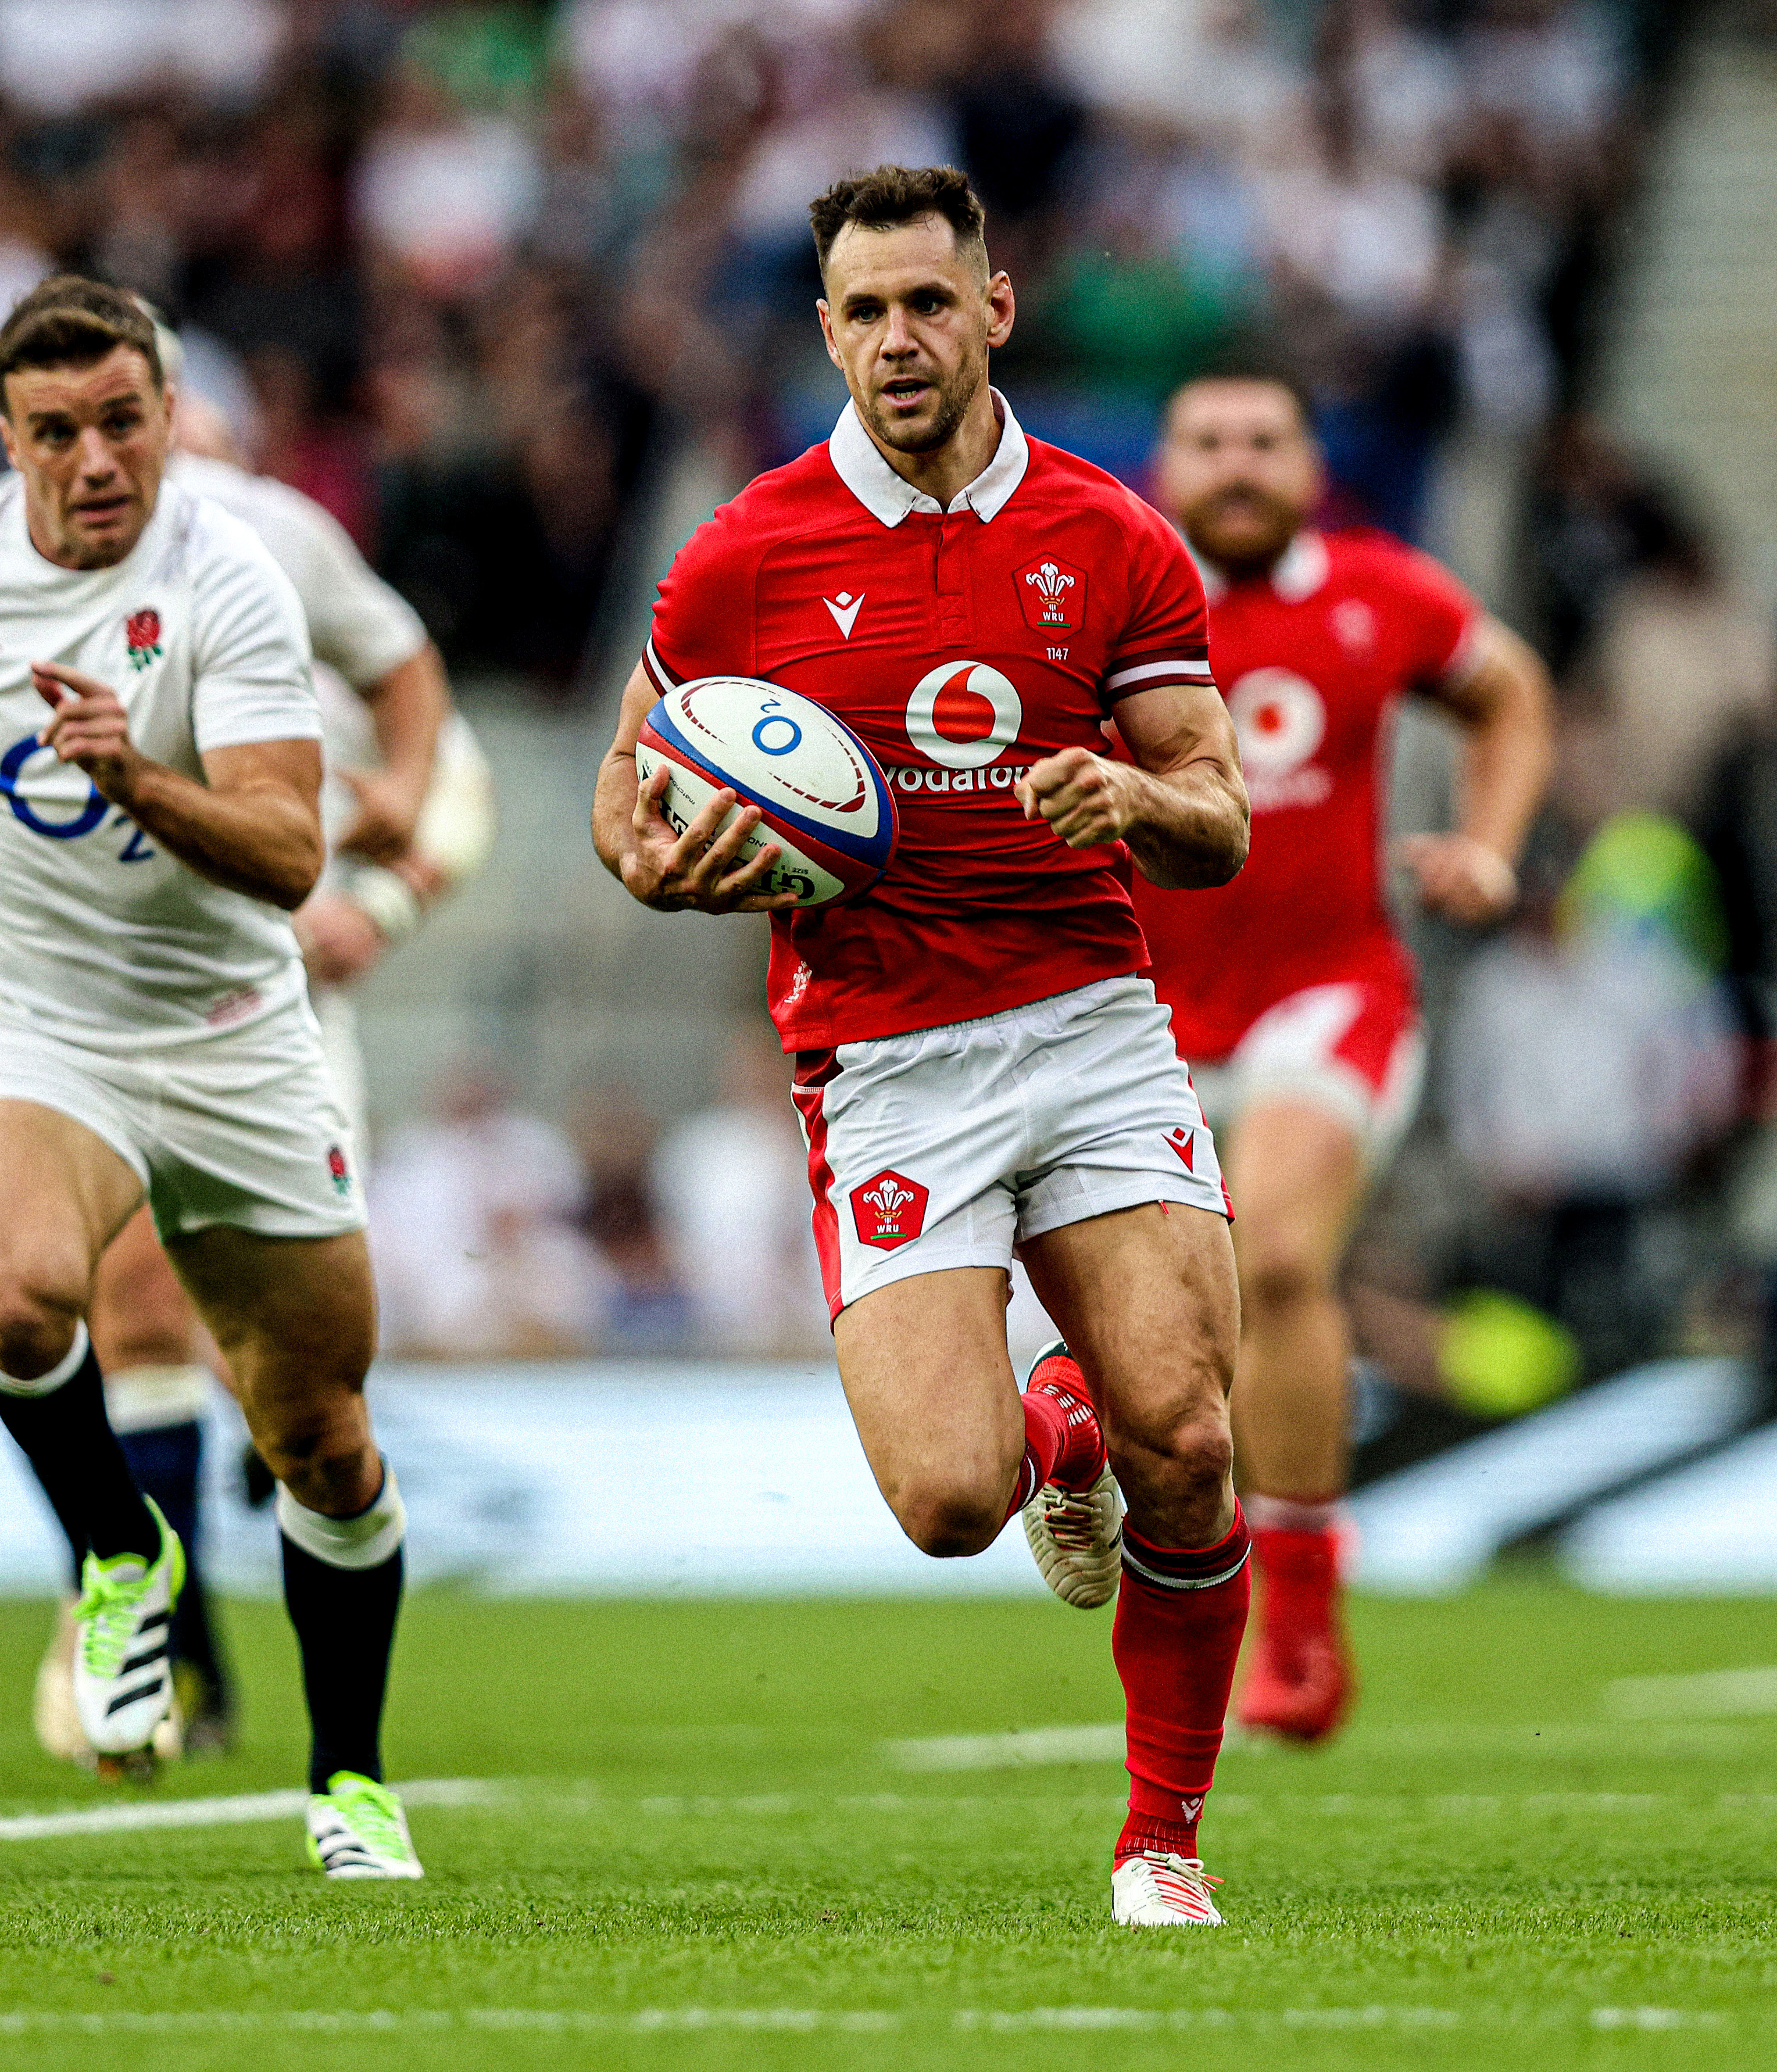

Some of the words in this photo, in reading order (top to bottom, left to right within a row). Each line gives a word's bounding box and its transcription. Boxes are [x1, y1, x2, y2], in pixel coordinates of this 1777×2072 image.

[1042, 611, 1064, 622] WRU
[1046, 647, 1069, 660] 1147
[751, 698, 802, 756] O2
[876, 1223, 900, 1234] WRU
